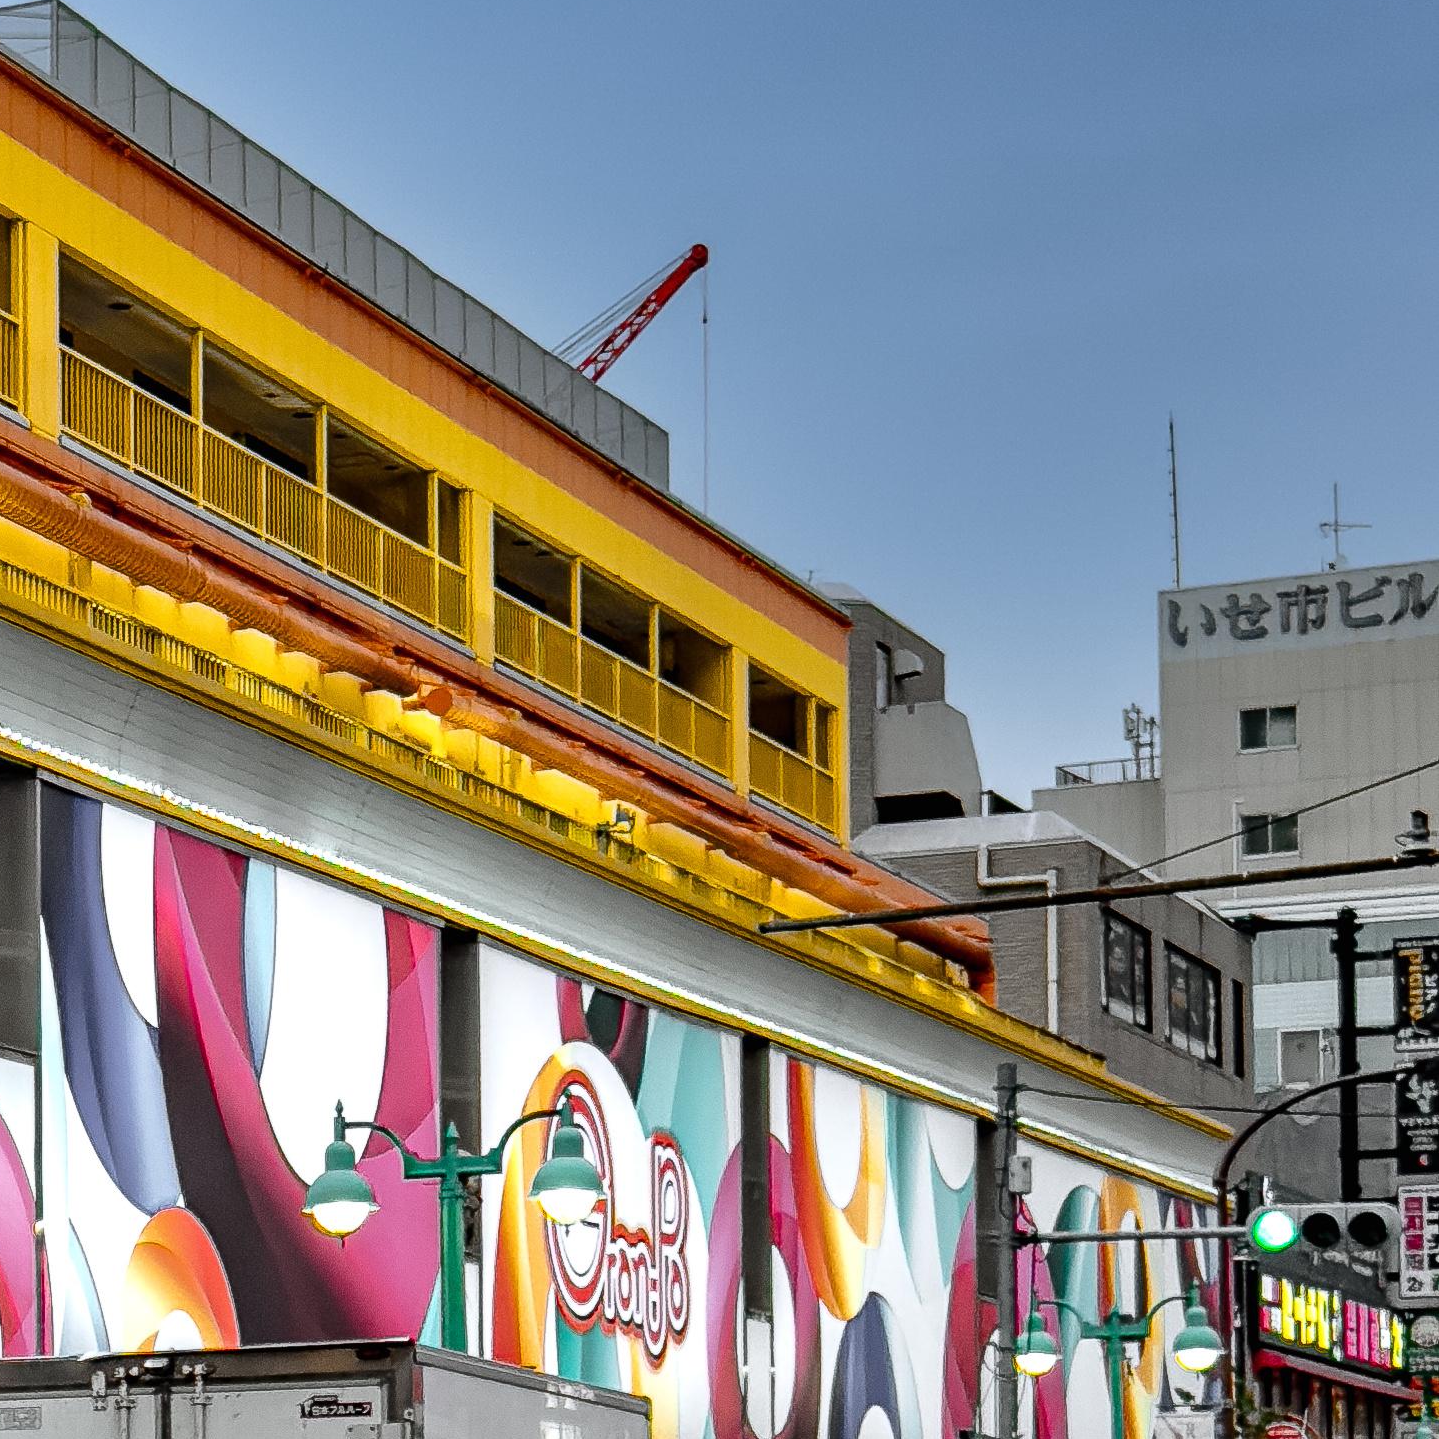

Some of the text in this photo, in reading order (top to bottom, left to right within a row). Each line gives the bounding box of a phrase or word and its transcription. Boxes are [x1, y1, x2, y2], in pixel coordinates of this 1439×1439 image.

[1167, 571, 1439, 647] いせ市ビル
